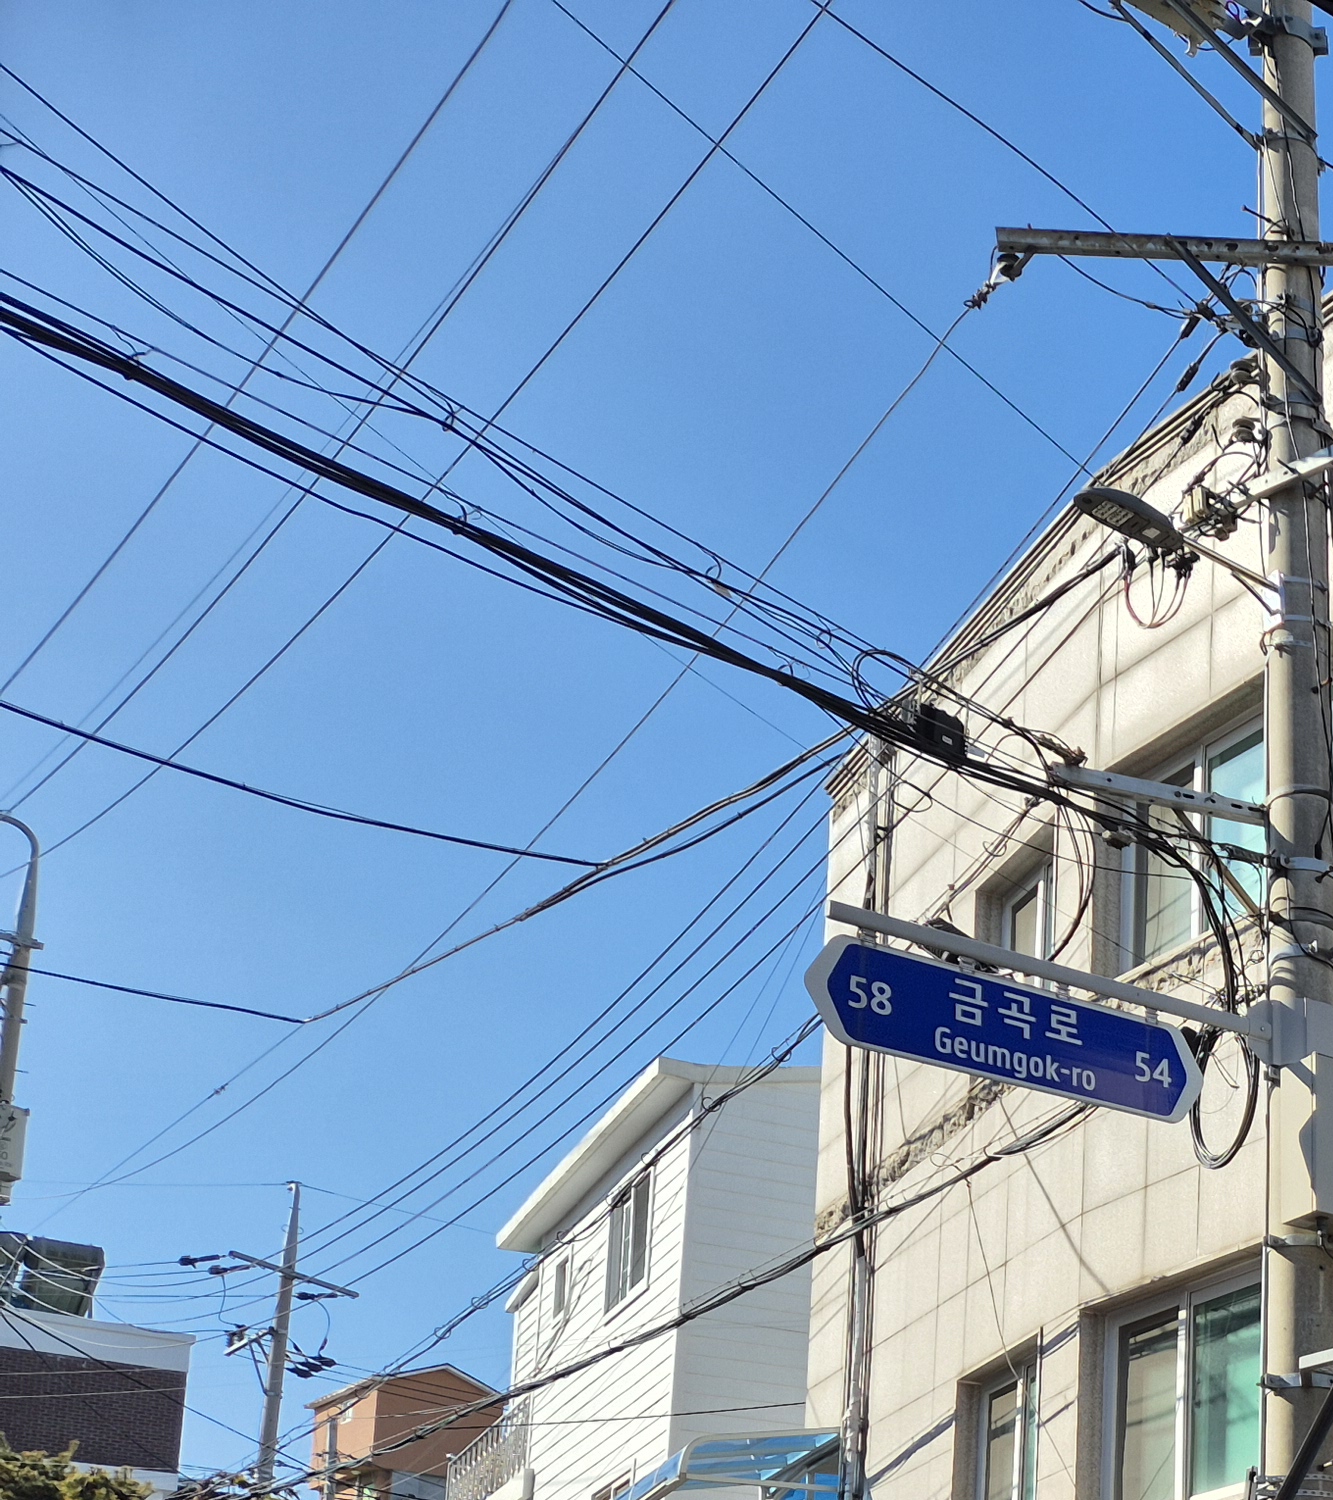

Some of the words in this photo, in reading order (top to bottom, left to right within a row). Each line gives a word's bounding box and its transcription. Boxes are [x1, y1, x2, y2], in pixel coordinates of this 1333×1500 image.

[847, 974, 893, 1016] 58
[948, 977, 1083, 1046] 금곡로
[934, 1026, 1096, 1092] Geumgok-ro
[1134, 1051, 1172, 1088] 54
